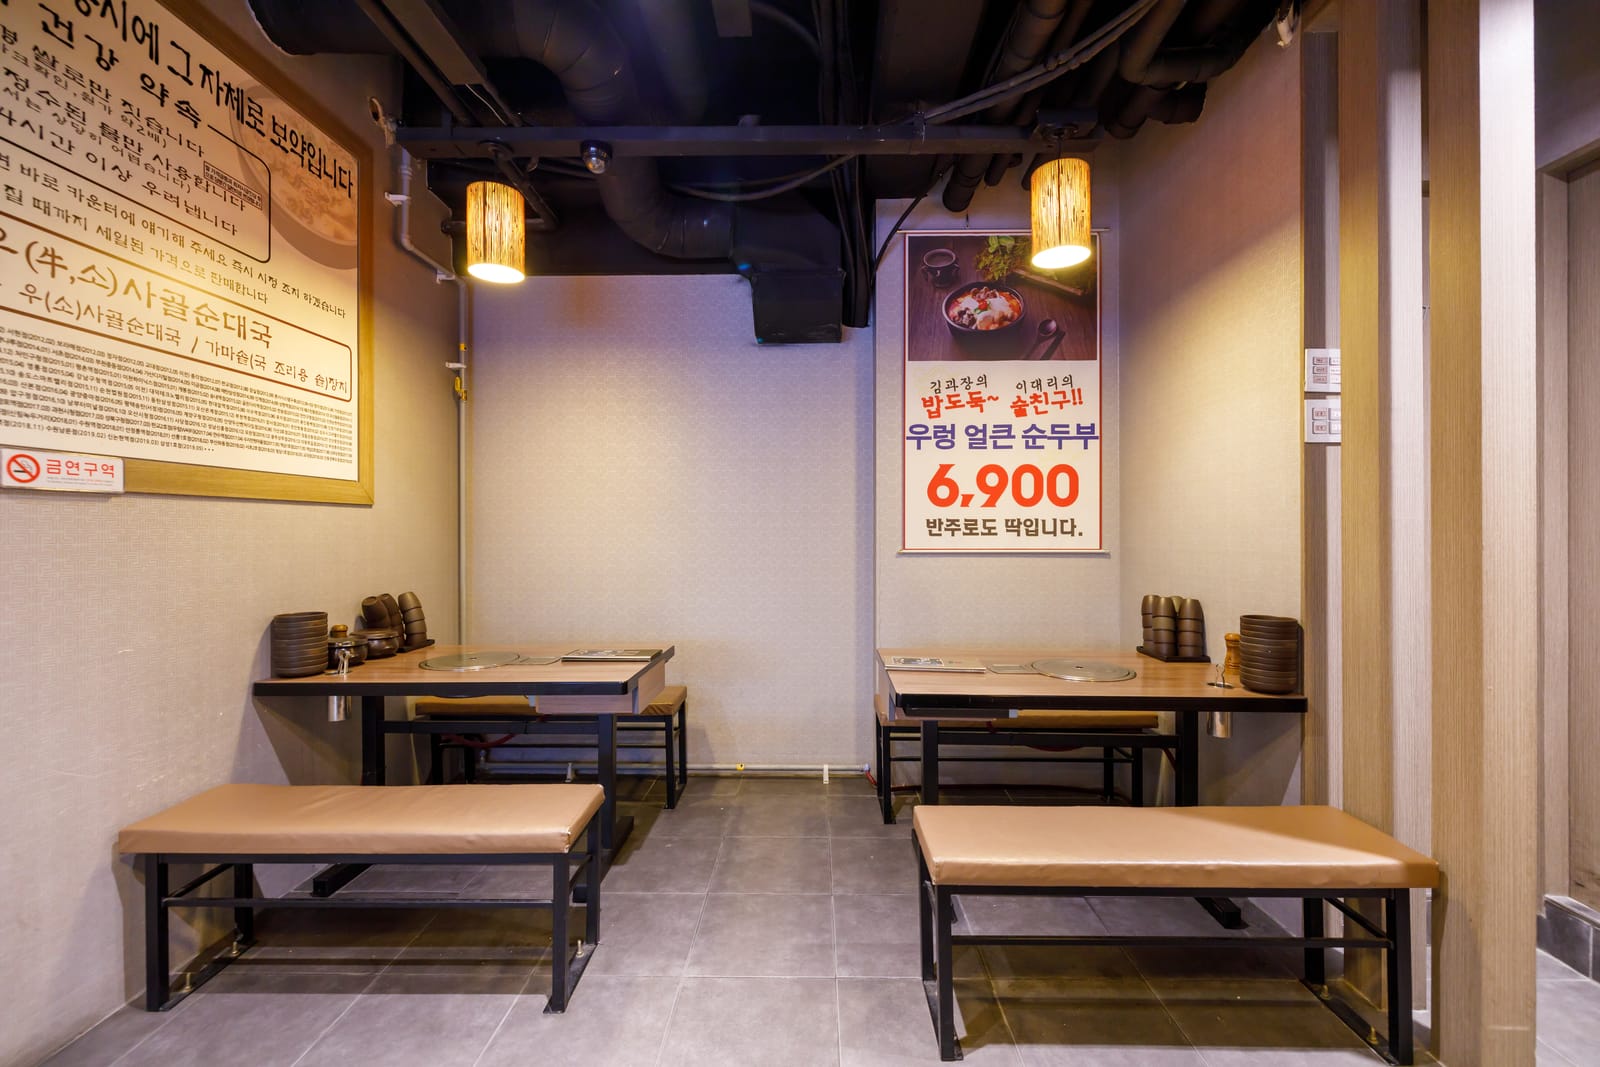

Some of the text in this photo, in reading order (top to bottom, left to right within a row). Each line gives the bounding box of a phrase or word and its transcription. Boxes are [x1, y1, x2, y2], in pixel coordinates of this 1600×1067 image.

[121, 98, 205, 158] 짓습니다
[99, 121, 144, 157] 물만
[153, 154, 246, 212] 사용합니다
[271, 115, 354, 198] 보약입니다
[86, 152, 133, 183] 이상
[142, 181, 238, 236] 우려냅니다
[20, 163, 60, 192] 바로
[67, 185, 136, 227] 카운터에
[141, 219, 185, 248] 얘기해
[190, 240, 229, 267] 주세요
[231, 258, 253, 279] 즉시
[32, 197, 87, 232] 때까지
[96, 225, 144, 255] 세일된
[150, 247, 206, 279] 가격으로
[210, 271, 269, 305] 판매합니다
[273, 361, 309, 382] 조리용
[929, 374, 1074, 394] 김과장의 이대리의
[1010, 388, 1083, 418] 술친구!!
[906, 423, 1099, 450] 우렁 얼큰 순두부
[46, 459, 115, 479] 금연구역
[926, 463, 1080, 508] 6,900
[925, 518, 1083, 538] 반주로도 딱입니다.
